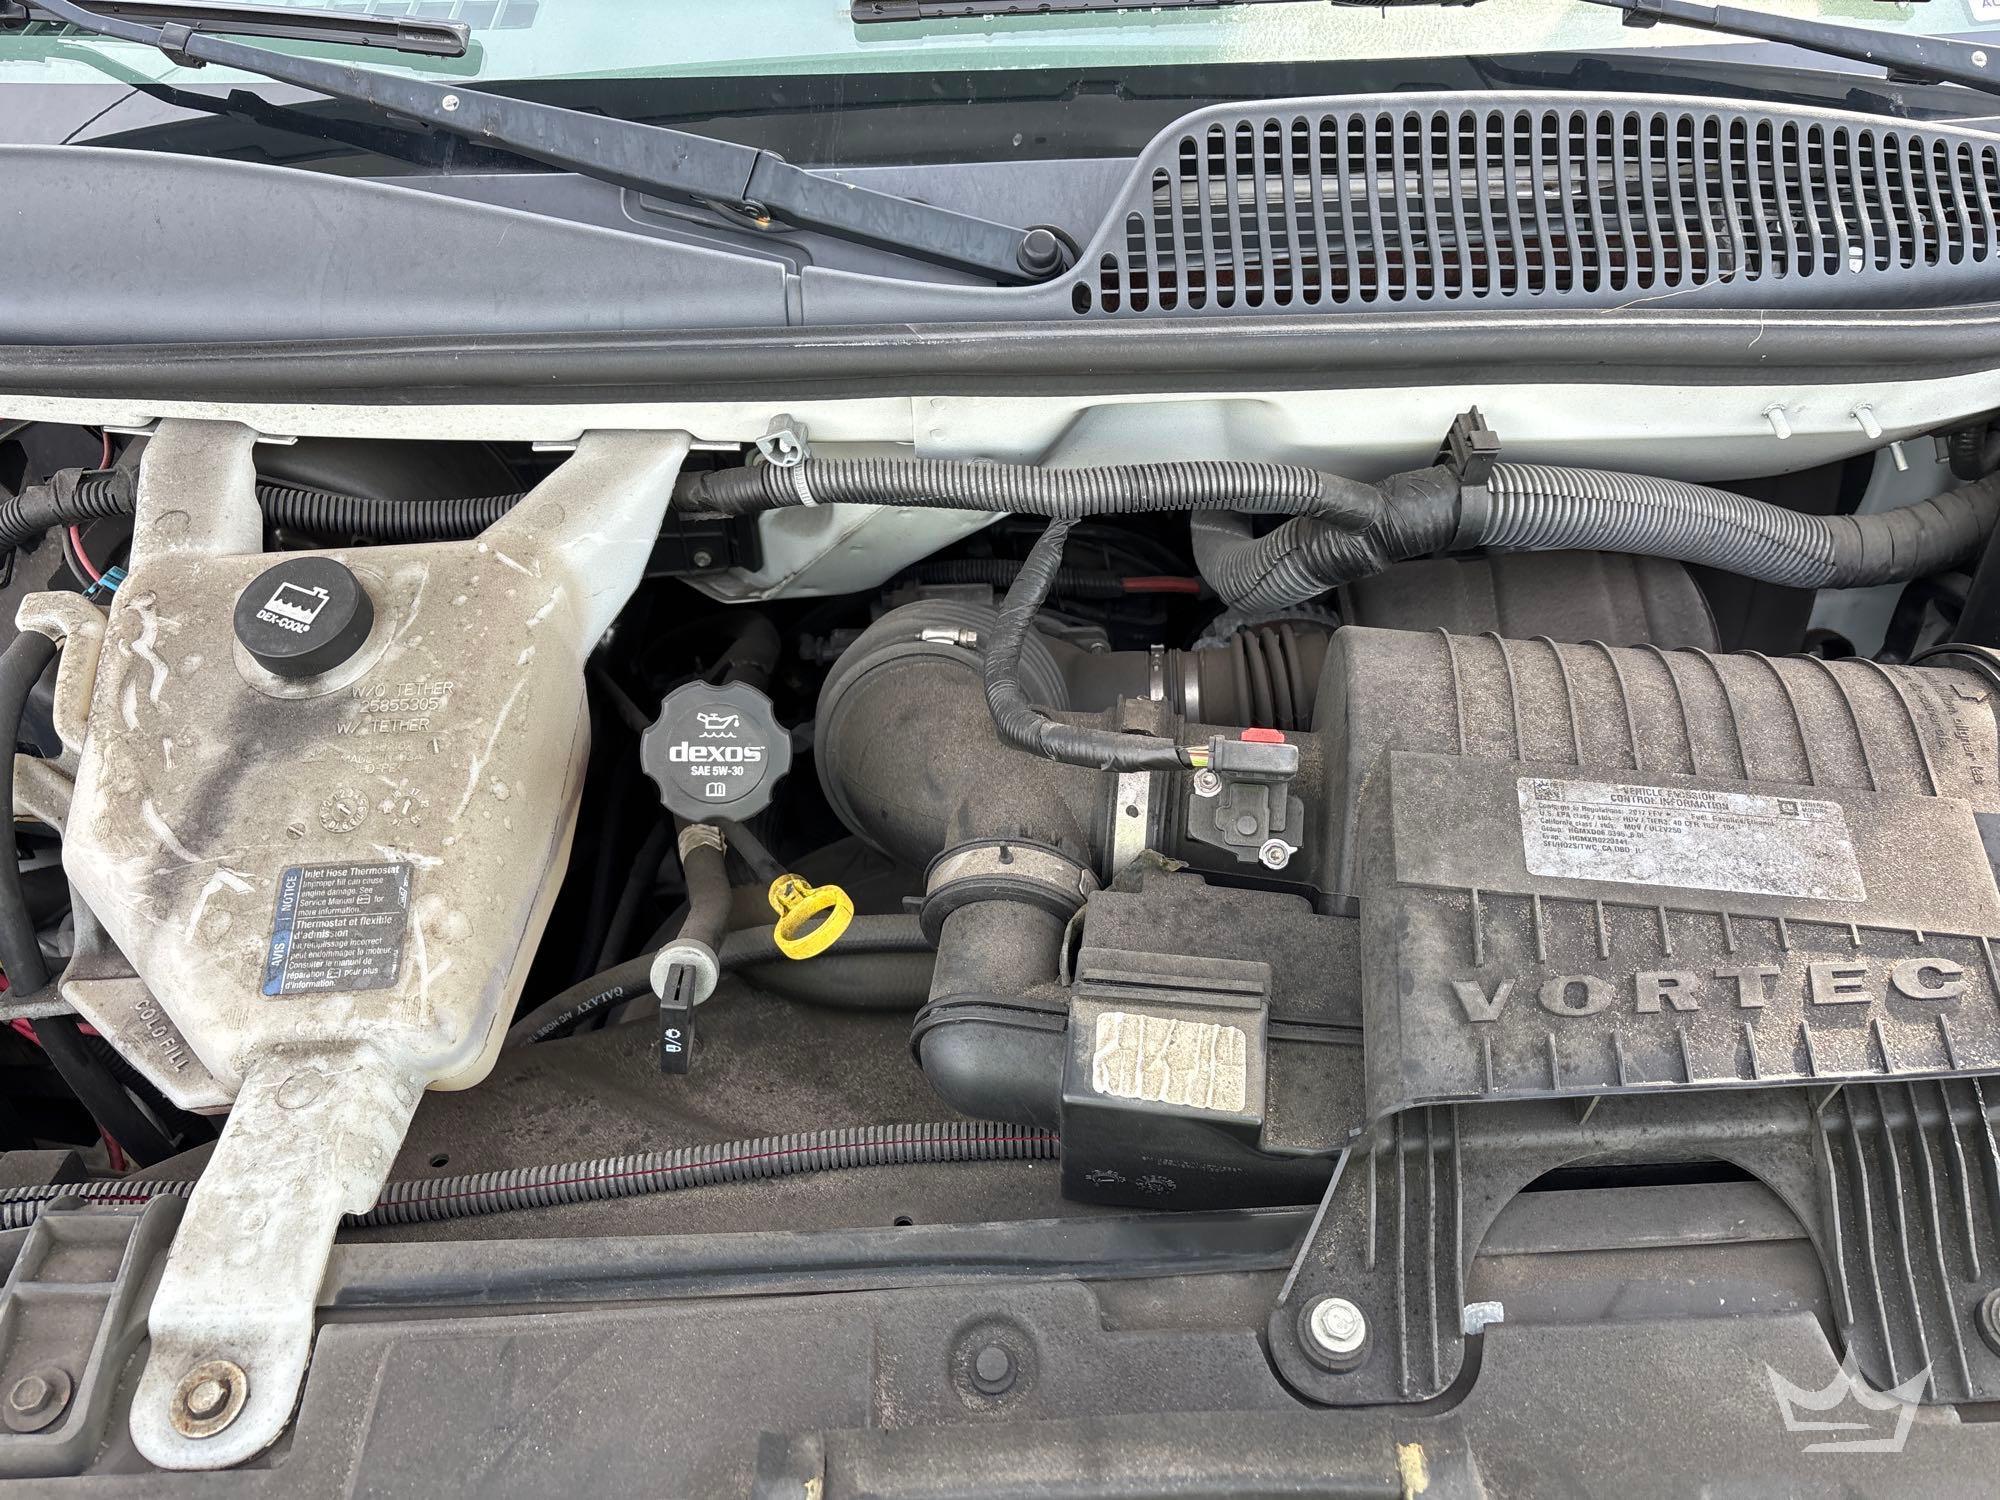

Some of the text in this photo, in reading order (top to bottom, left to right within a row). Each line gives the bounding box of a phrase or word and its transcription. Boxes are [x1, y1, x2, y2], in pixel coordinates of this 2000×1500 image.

[352, 681, 454, 698] W/O TETHER
[360, 697, 441, 713] 25855305
[336, 717, 430, 735] W/ TETHER
[669, 741, 762, 762] dexos
[690, 765, 744, 776] SAE 5W-30
[1610, 794, 1730, 810] CONTROL INFORMATION
[1628, 808, 1646, 816] 2017
[1602, 844, 1612, 852] CA
[304, 869, 325, 879] Inlet
[326, 868, 348, 878] Hose
[350, 865, 400, 877] Thermostat
[303, 879, 335, 888] Improper
[347, 878, 361, 886] can
[362, 876, 384, 885] cause
[281, 875, 298, 912] NOTICE
[301, 889, 326, 898] engine
[360, 886, 373, 894] See
[300, 895, 384, 907] Service Manual for
[298, 905, 361, 916] more information.
[296, 916, 393, 930] Thermostat et flexible
[293, 929, 349, 940] d'admission
[350, 937, 382, 946] incorrect
[271, 942, 286, 967] AVIS
[308, 949, 356, 960] endommager
[288, 960, 324, 970] Consulter
[334, 958, 361, 968] manuel
[362, 957, 373, 965] de
[344, 968, 361, 977] pour
[362, 966, 379, 976] plus
[284, 979, 336, 990] d'information.
[1451, 957, 1966, 1024] VORTEC
[577, 986, 624, 1015] GALAXY
[134, 999, 189, 1073] COLD FILL
